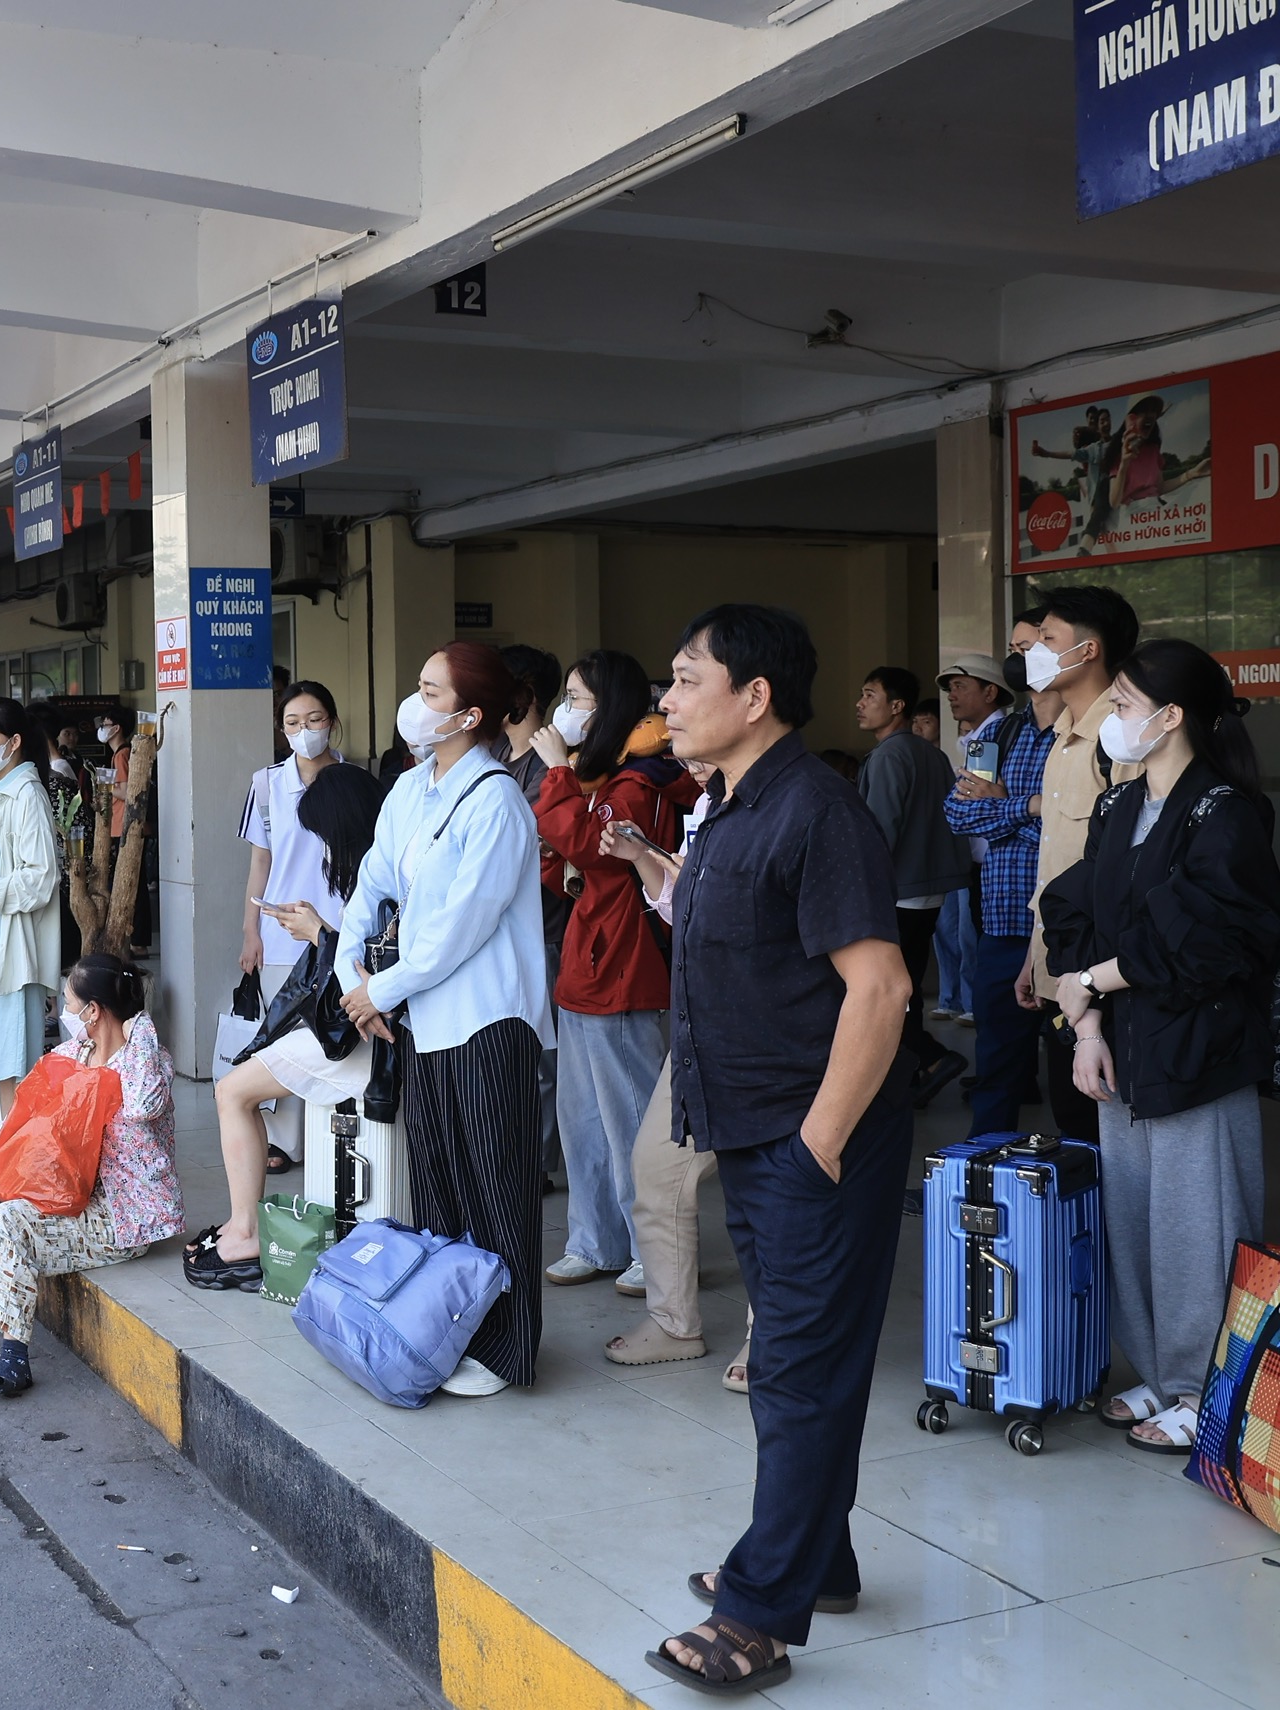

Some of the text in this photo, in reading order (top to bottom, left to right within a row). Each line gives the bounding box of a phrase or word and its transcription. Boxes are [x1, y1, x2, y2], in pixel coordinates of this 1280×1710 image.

[1098, 0, 1180, 89] NGHĨA
[1148, 75, 1247, 171] (NAM
[447, 280, 481, 310] 12
[290, 304, 338, 352] A1-12
[270, 368, 320, 417] TRỰC NINH
[32, 440, 57, 469] A1-11
[1130, 503, 1206, 525] NGHỈ XẢ HƠI
[1135, 524, 1170, 541] HỨNG
[1174, 518, 1206, 536] KHỞI
[226, 578, 255, 596] NGHỊ
[195, 597, 264, 616] QUÝ KHÁCH
[210, 622, 253, 637] KHONG
